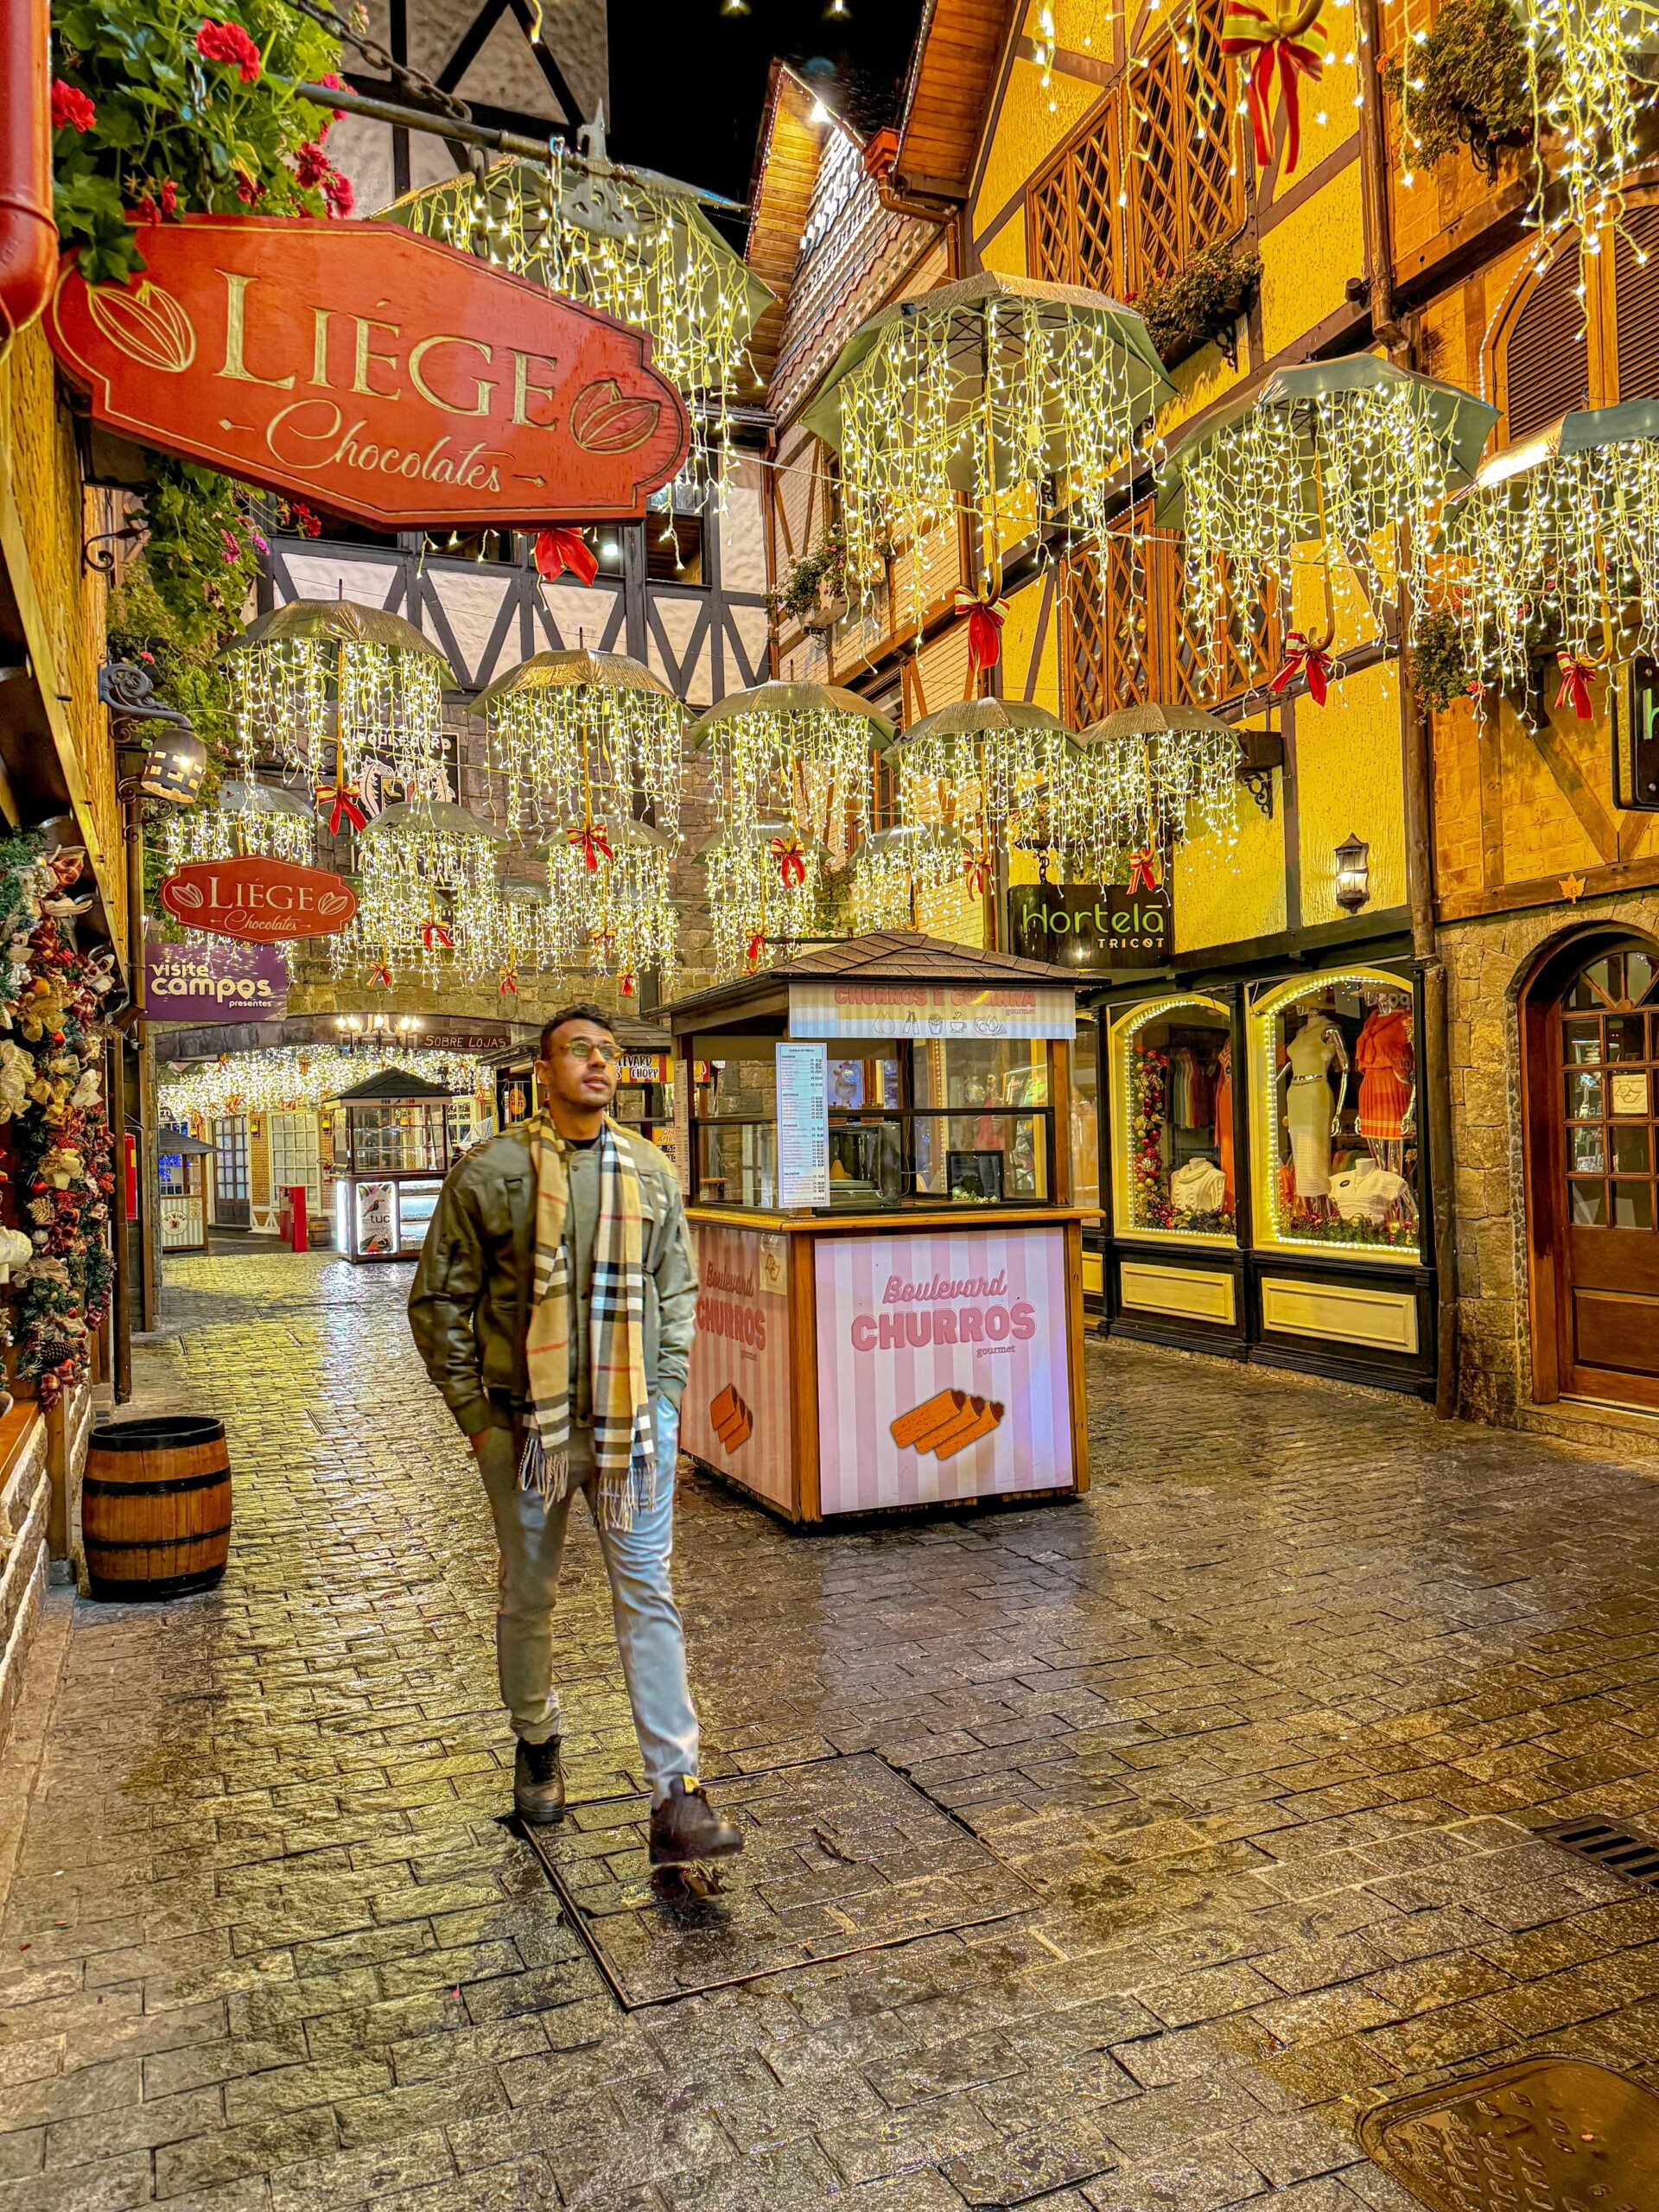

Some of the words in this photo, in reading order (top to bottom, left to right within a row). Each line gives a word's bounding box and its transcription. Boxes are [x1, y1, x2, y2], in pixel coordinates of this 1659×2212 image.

[266, 398, 515, 493] Chocolates
[225, 909, 302, 931] Chocolates
[1097, 938, 1164, 949] TRICOT
[149, 958, 209, 977] visite
[150, 977, 272, 1003] campos
[835, 988, 928, 1007] CHURROS
[933, 988, 945, 1007] E
[228, 999, 272, 1008] presentes
[1005, 1007, 1036, 1016] gourmet
[424, 1035, 464, 1047] SOBRE
[468, 1038, 506, 1048] LOJAS
[632, 1068, 658, 1078] CHOPP
[706, 1261, 754, 1298] Boulevard
[882, 1268, 1009, 1305] Boulevard
[696, 1295, 766, 1351] CHURROS
[851, 1301, 1037, 1352] CHURROS
[976, 1344, 1016, 1358] gourmet
